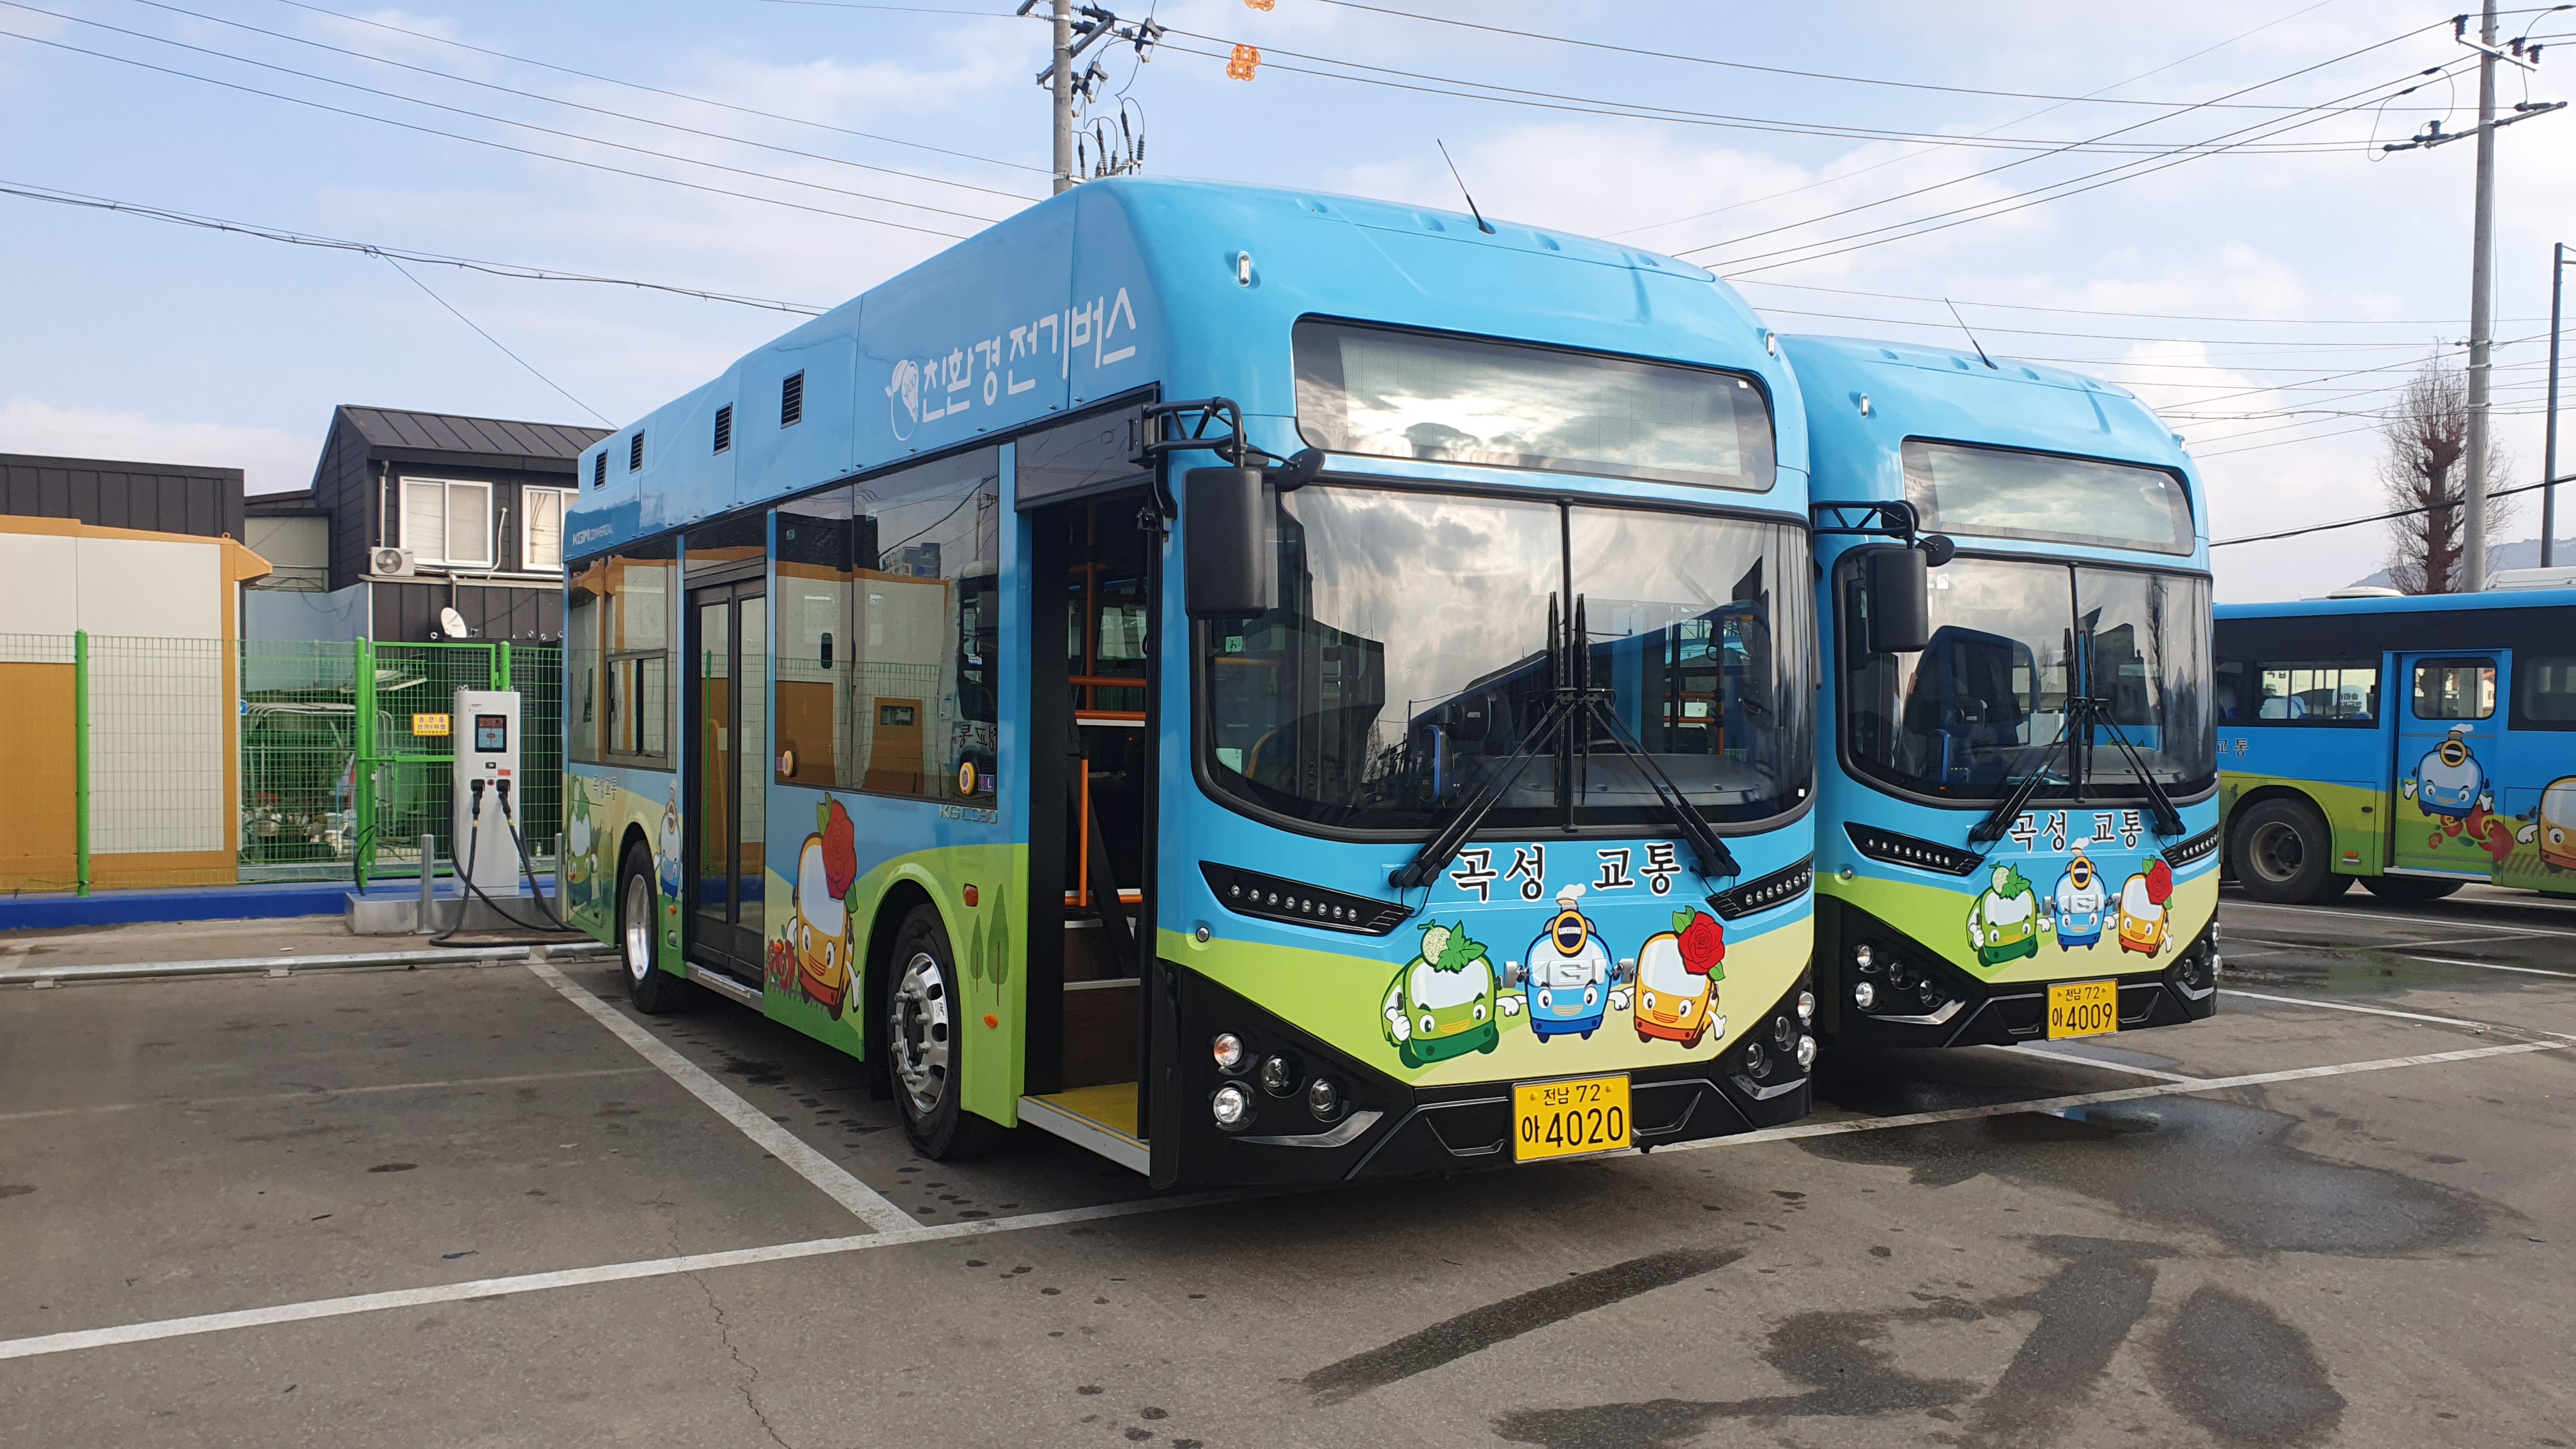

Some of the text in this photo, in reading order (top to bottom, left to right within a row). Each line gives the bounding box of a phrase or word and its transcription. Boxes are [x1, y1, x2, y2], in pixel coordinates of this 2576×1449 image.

[923, 287, 1137, 423] 친환경 전기버스
[2009, 809, 2143, 853] 곡성 교통
[1450, 841, 1682, 903] 곡성 교통
[2065, 986, 2100, 1001] 전남 72
[2052, 1002, 2113, 1031] 아4009
[1543, 1084, 1601, 1106] 전남 72
[1521, 1106, 1623, 1148] 아4020
